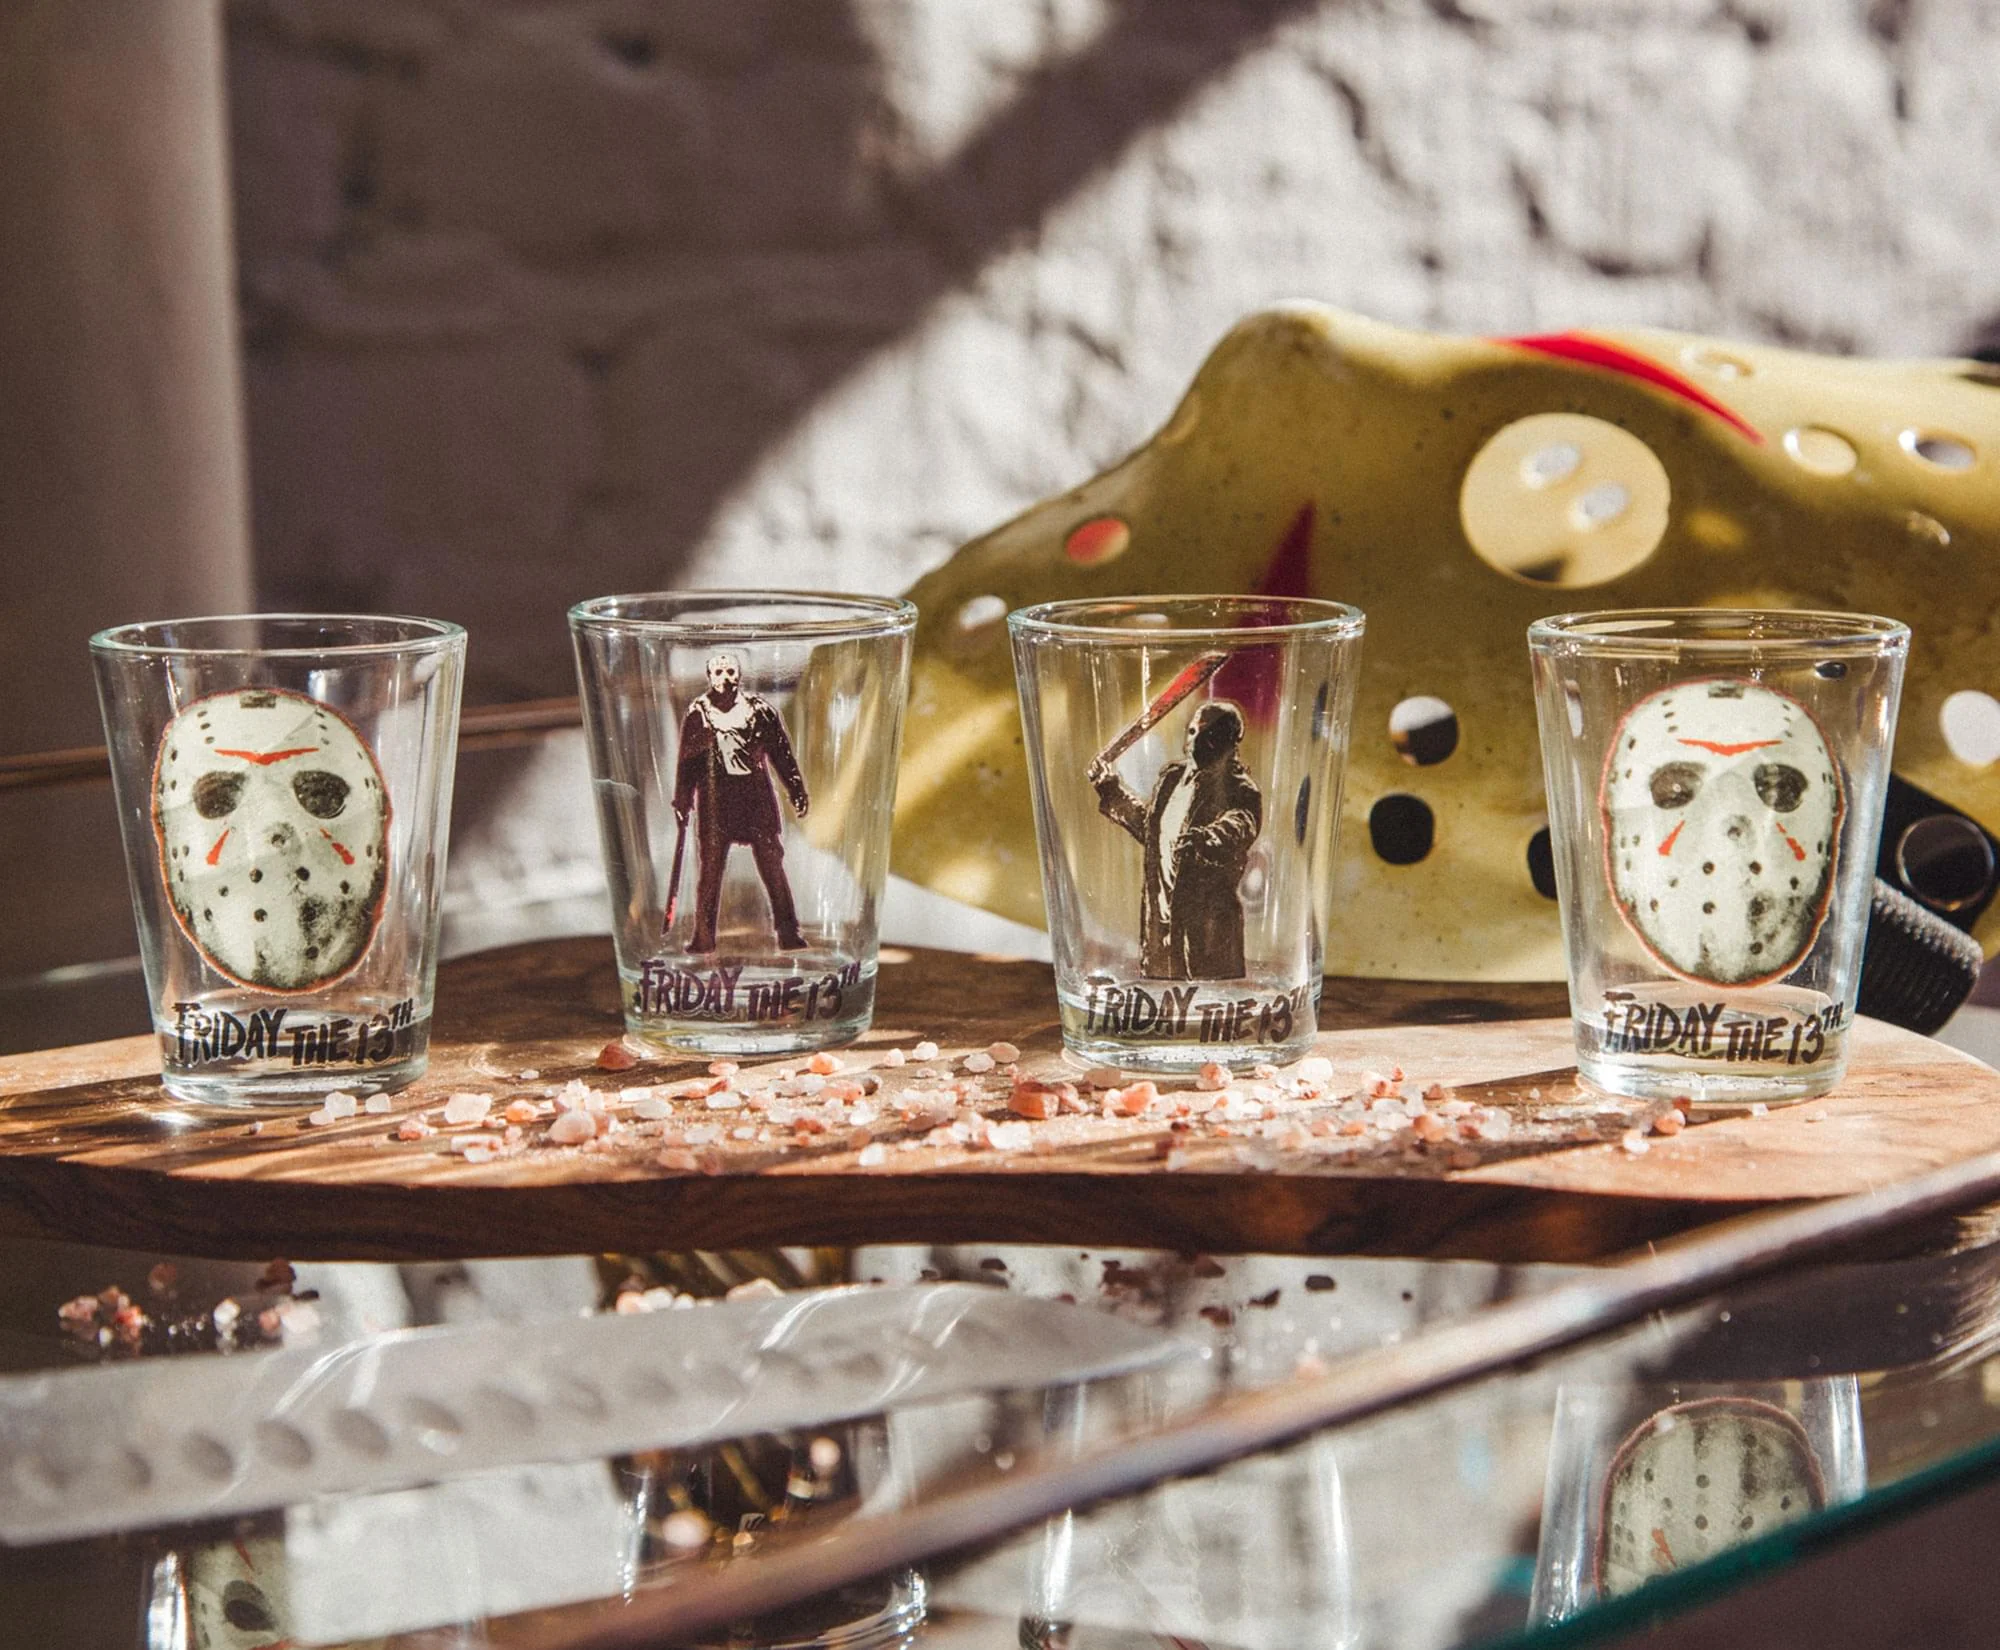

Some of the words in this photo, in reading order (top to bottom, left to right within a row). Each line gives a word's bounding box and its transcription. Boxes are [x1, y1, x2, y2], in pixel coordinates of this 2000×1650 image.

[639, 960, 744, 1015] FRIDAY
[744, 977, 804, 1021] THE
[1084, 976, 1199, 1036] FRIDAY
[1194, 999, 1257, 1043] THE
[172, 1002, 288, 1062] FRIDAY
[285, 1019, 353, 1066] THE
[1602, 991, 1726, 1050] FRIDAY
[1723, 1017, 1789, 1062] THE
